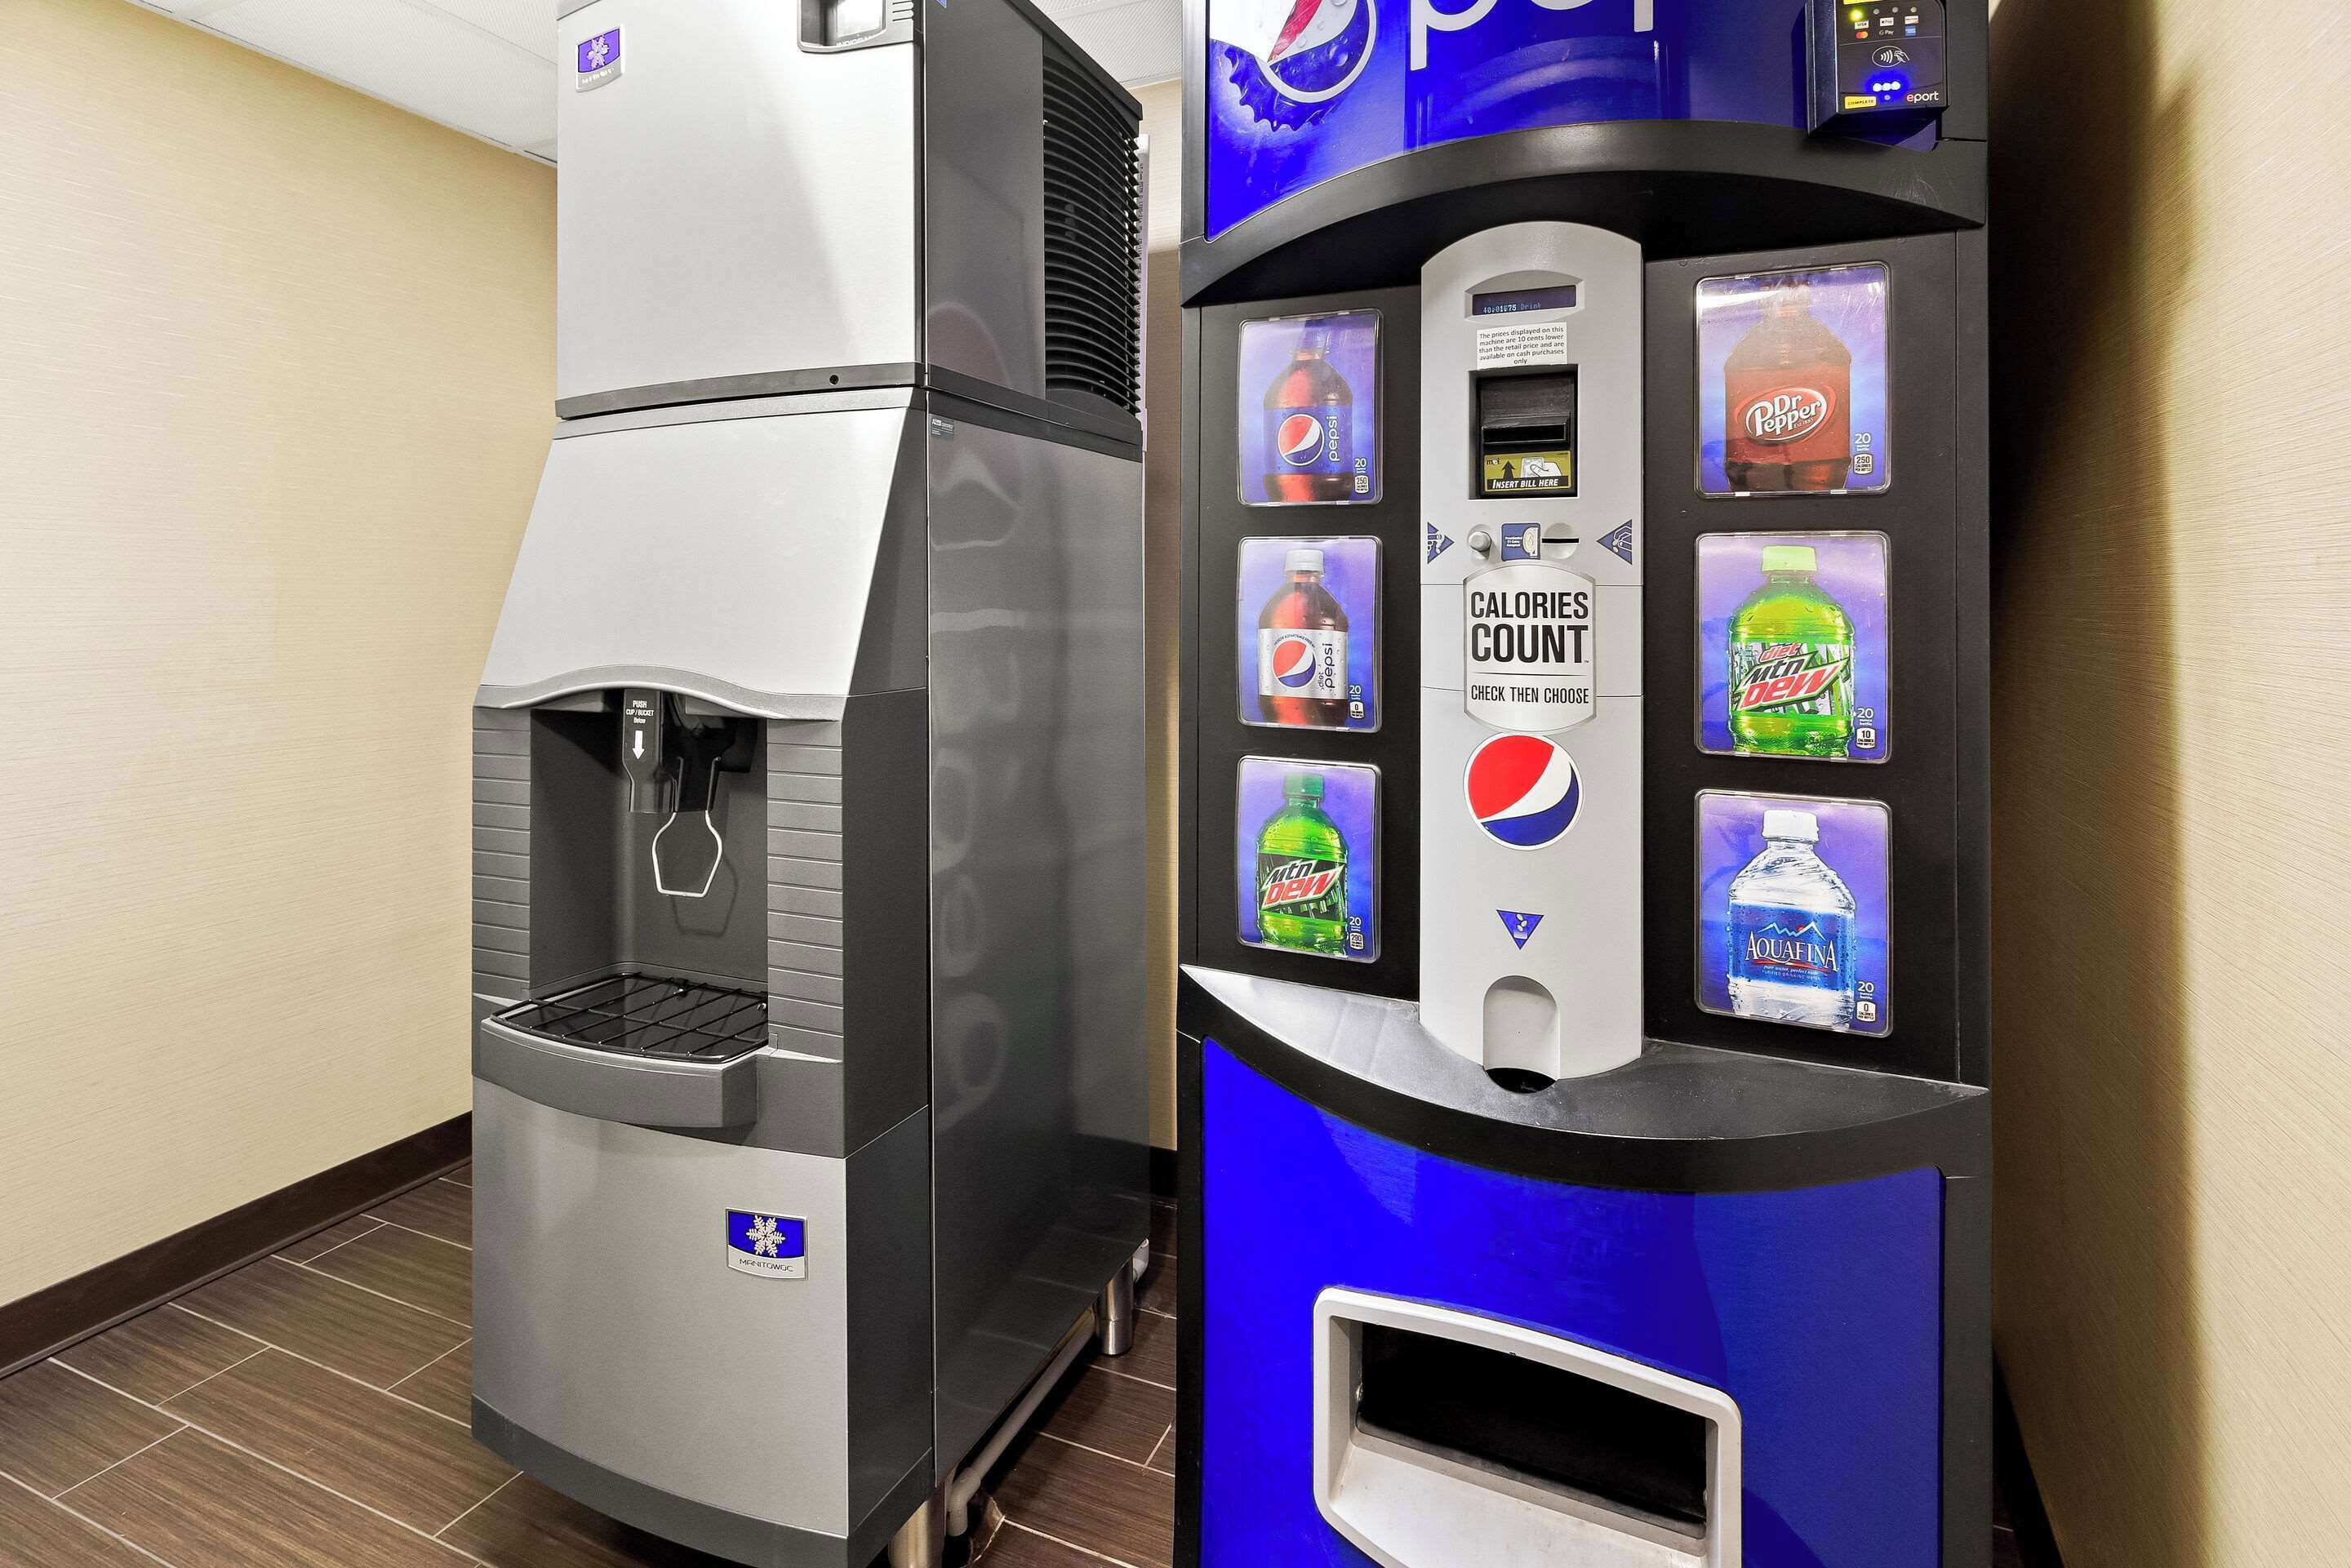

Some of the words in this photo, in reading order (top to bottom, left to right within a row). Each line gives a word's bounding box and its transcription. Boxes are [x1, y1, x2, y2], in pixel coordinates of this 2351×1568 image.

[1906, 91, 1939, 104] eport
[1520, 302, 1542, 310] Drink
[1532, 349, 1564, 357] purchases
[1773, 394, 1802, 417] Dr
[1748, 400, 1821, 437] Pepper
[1327, 415, 1340, 462] pepsi
[1854, 433, 1871, 444] 20
[1354, 458, 1367, 468] 20
[1492, 479, 1519, 489] INSERT
[1520, 479, 1536, 487] BILL
[1538, 478, 1559, 487] HERE
[1470, 591, 1589, 619] CALORIES
[1471, 623, 1589, 664] COUNT
[1760, 644, 1800, 661] diet
[1322, 643, 1335, 688] pepsi
[1349, 685, 1362, 695] 20
[1471, 685, 1505, 701] CHECK
[1509, 686, 1539, 703] THEN
[1544, 687, 1589, 704] CHOOSE
[1857, 708, 1873, 718] 20
[1861, 730, 1871, 739] 10
[1349, 916, 1362, 926] 20
[1745, 931, 1839, 971] AQUAFINA
[1857, 981, 1874, 993] 20
[1864, 1003, 1869, 1011] 0
[739, 1258, 794, 1272] MANITOWOC
